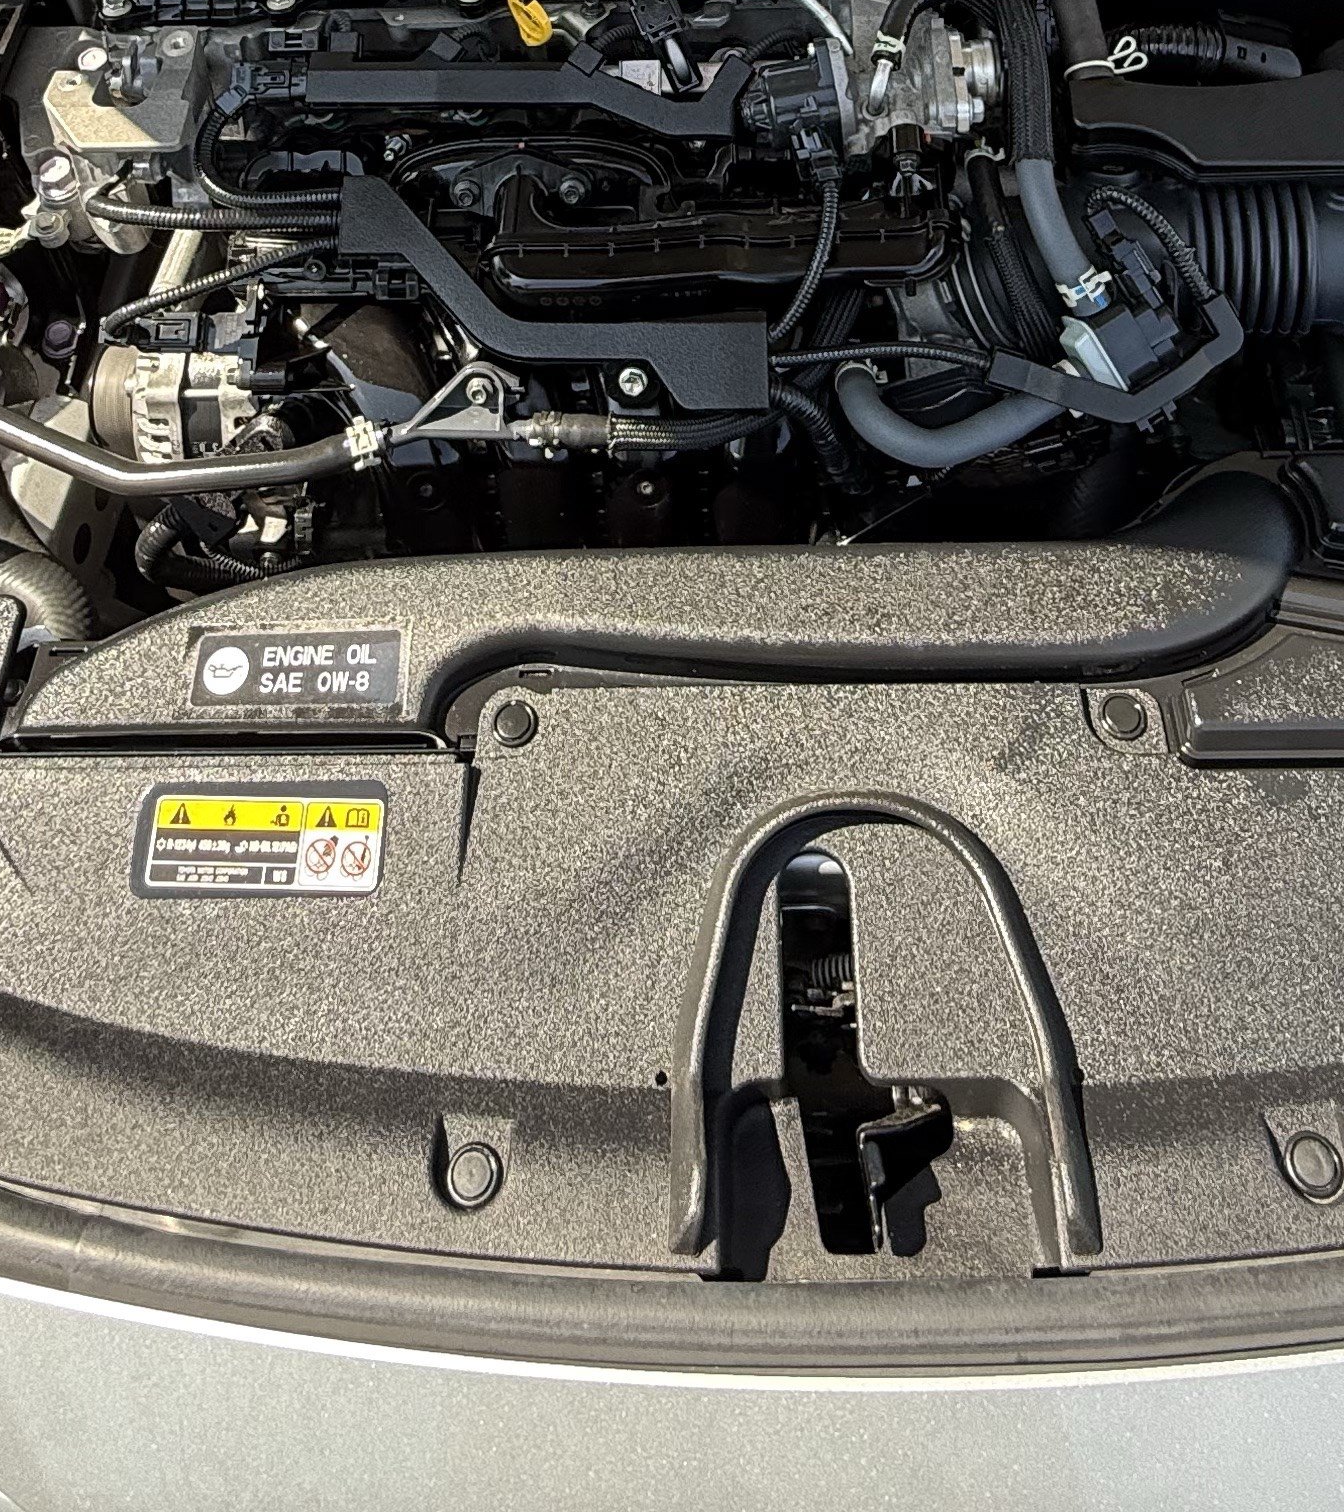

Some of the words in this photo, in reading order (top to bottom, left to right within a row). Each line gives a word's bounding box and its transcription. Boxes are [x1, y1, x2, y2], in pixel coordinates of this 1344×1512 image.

[261, 644, 335, 667] ENGINE
[346, 643, 377, 665] OIL
[258, 672, 303, 694] SAE
[316, 670, 370, 693] 0W-8
